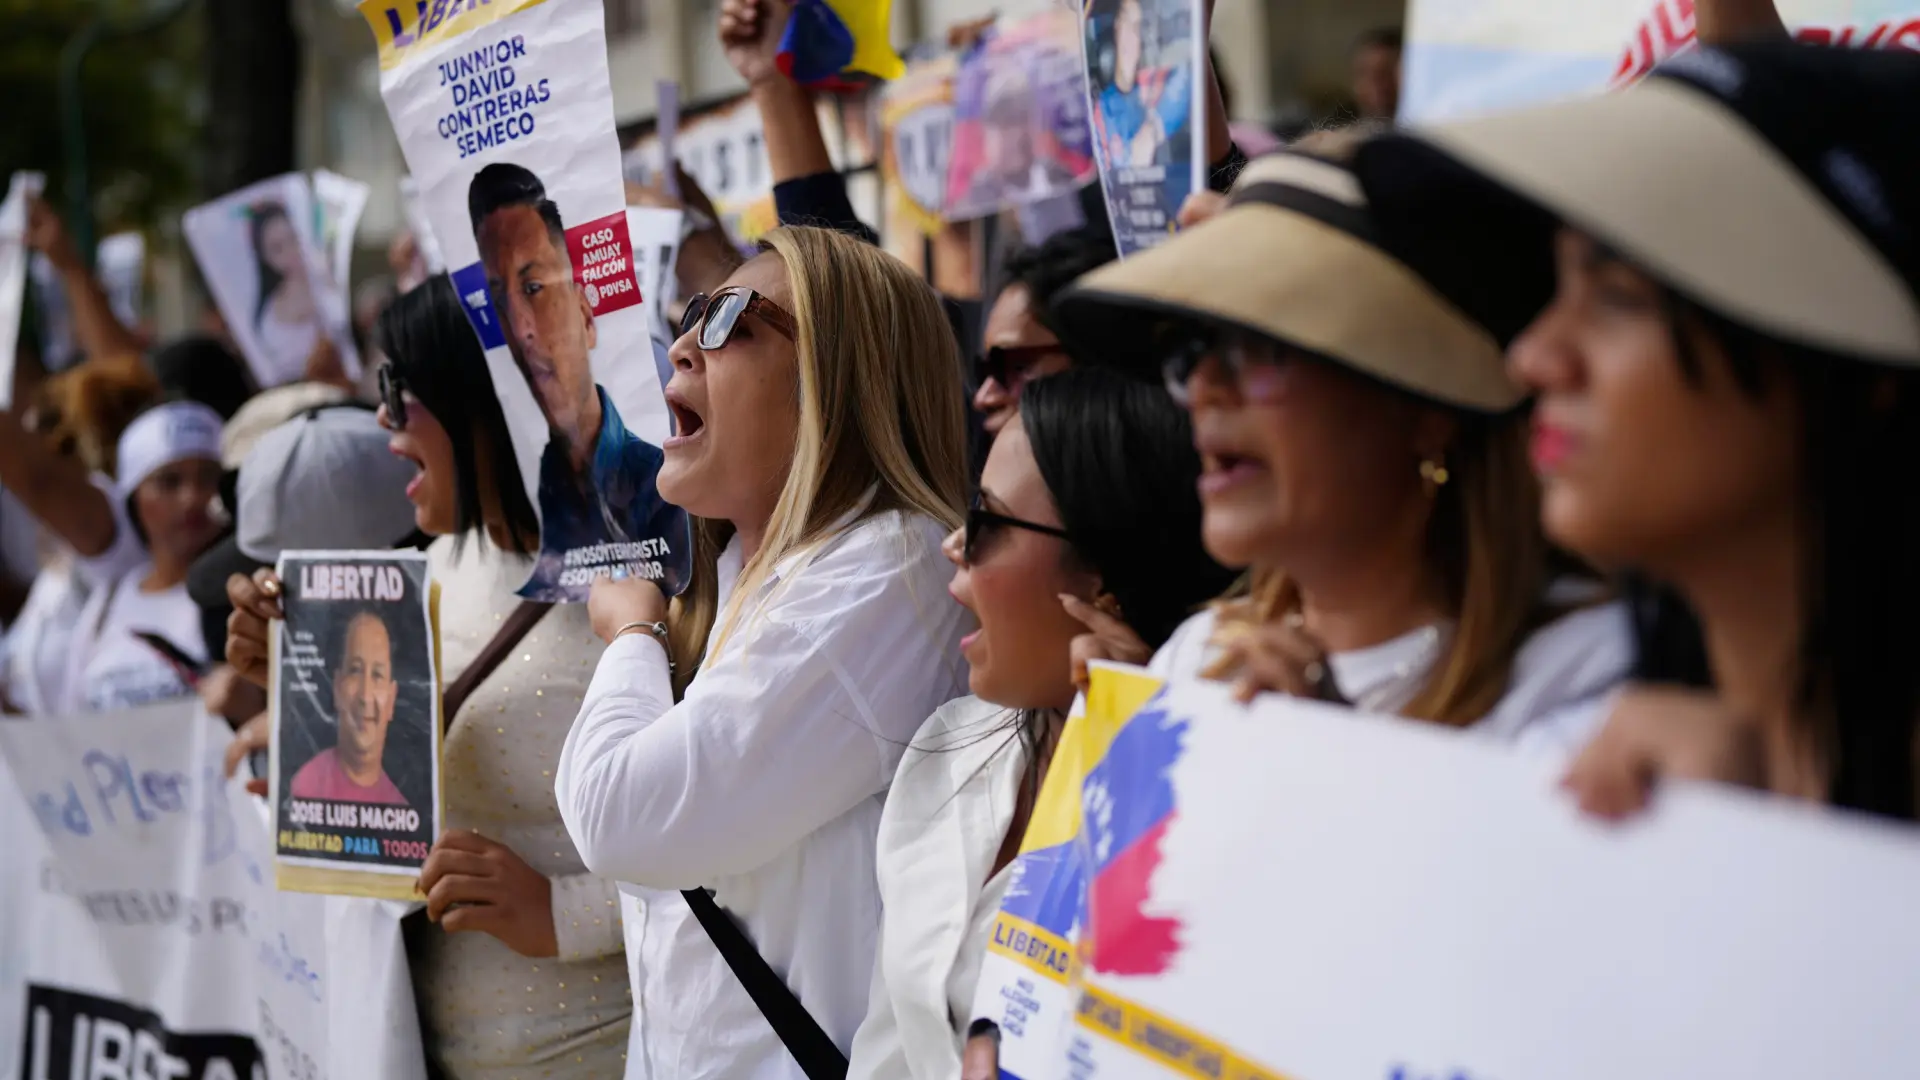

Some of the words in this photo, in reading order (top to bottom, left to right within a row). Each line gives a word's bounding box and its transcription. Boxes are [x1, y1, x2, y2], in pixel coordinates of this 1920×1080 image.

[437, 34, 527, 87] JUNNIOR
[452, 65, 516, 107] DAVID
[437, 78, 551, 140] CONTRERAS
[456, 112, 536, 159] SEMECO
[582, 228, 614, 250] CASO
[582, 243, 622, 268] AMUAY
[582, 256, 627, 283] FALCÓN
[599, 278, 633, 299] PDVSA
[300, 564, 405, 601] LIBERTAD
[289, 800, 324, 824] JOSE
[326, 802, 358, 828] LUIS
[361, 805, 421, 832] MACHO
[278, 830, 344, 853] #LIBERTAD
[344, 835, 380, 857] PARA
[383, 838, 430, 860] TODOS
